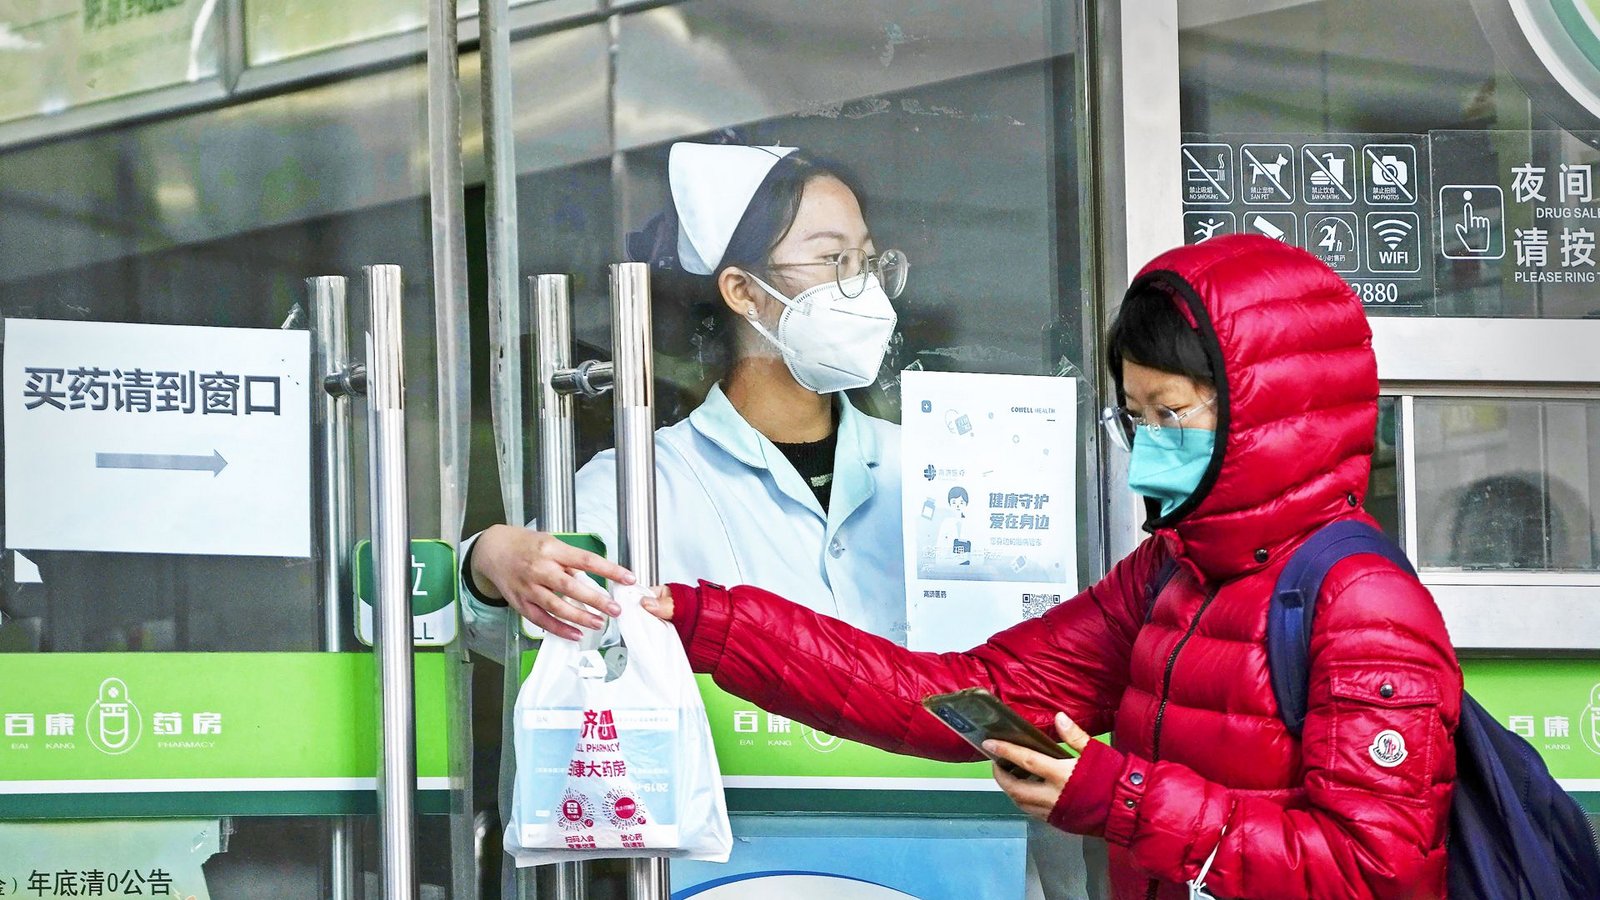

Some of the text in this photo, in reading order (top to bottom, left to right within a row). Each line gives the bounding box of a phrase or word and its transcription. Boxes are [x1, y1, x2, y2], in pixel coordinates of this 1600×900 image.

[1511, 163, 1593, 202] 夜间
[1536, 207, 1571, 219] DRUG
[1379, 251, 1409, 264] WIFI
[1513, 227, 1596, 267] 请按
[1515, 271, 1563, 283] PLEASE
[1565, 271, 1595, 283] RING
[23, 367, 281, 416] 买药请到窗口
[988, 492, 1050, 510] 健康守护
[989, 512, 1050, 530] 爱在身边
[5, 713, 75, 737] 百康
[153, 712, 222, 736] 药房
[1508, 715, 1570, 738] 百康
